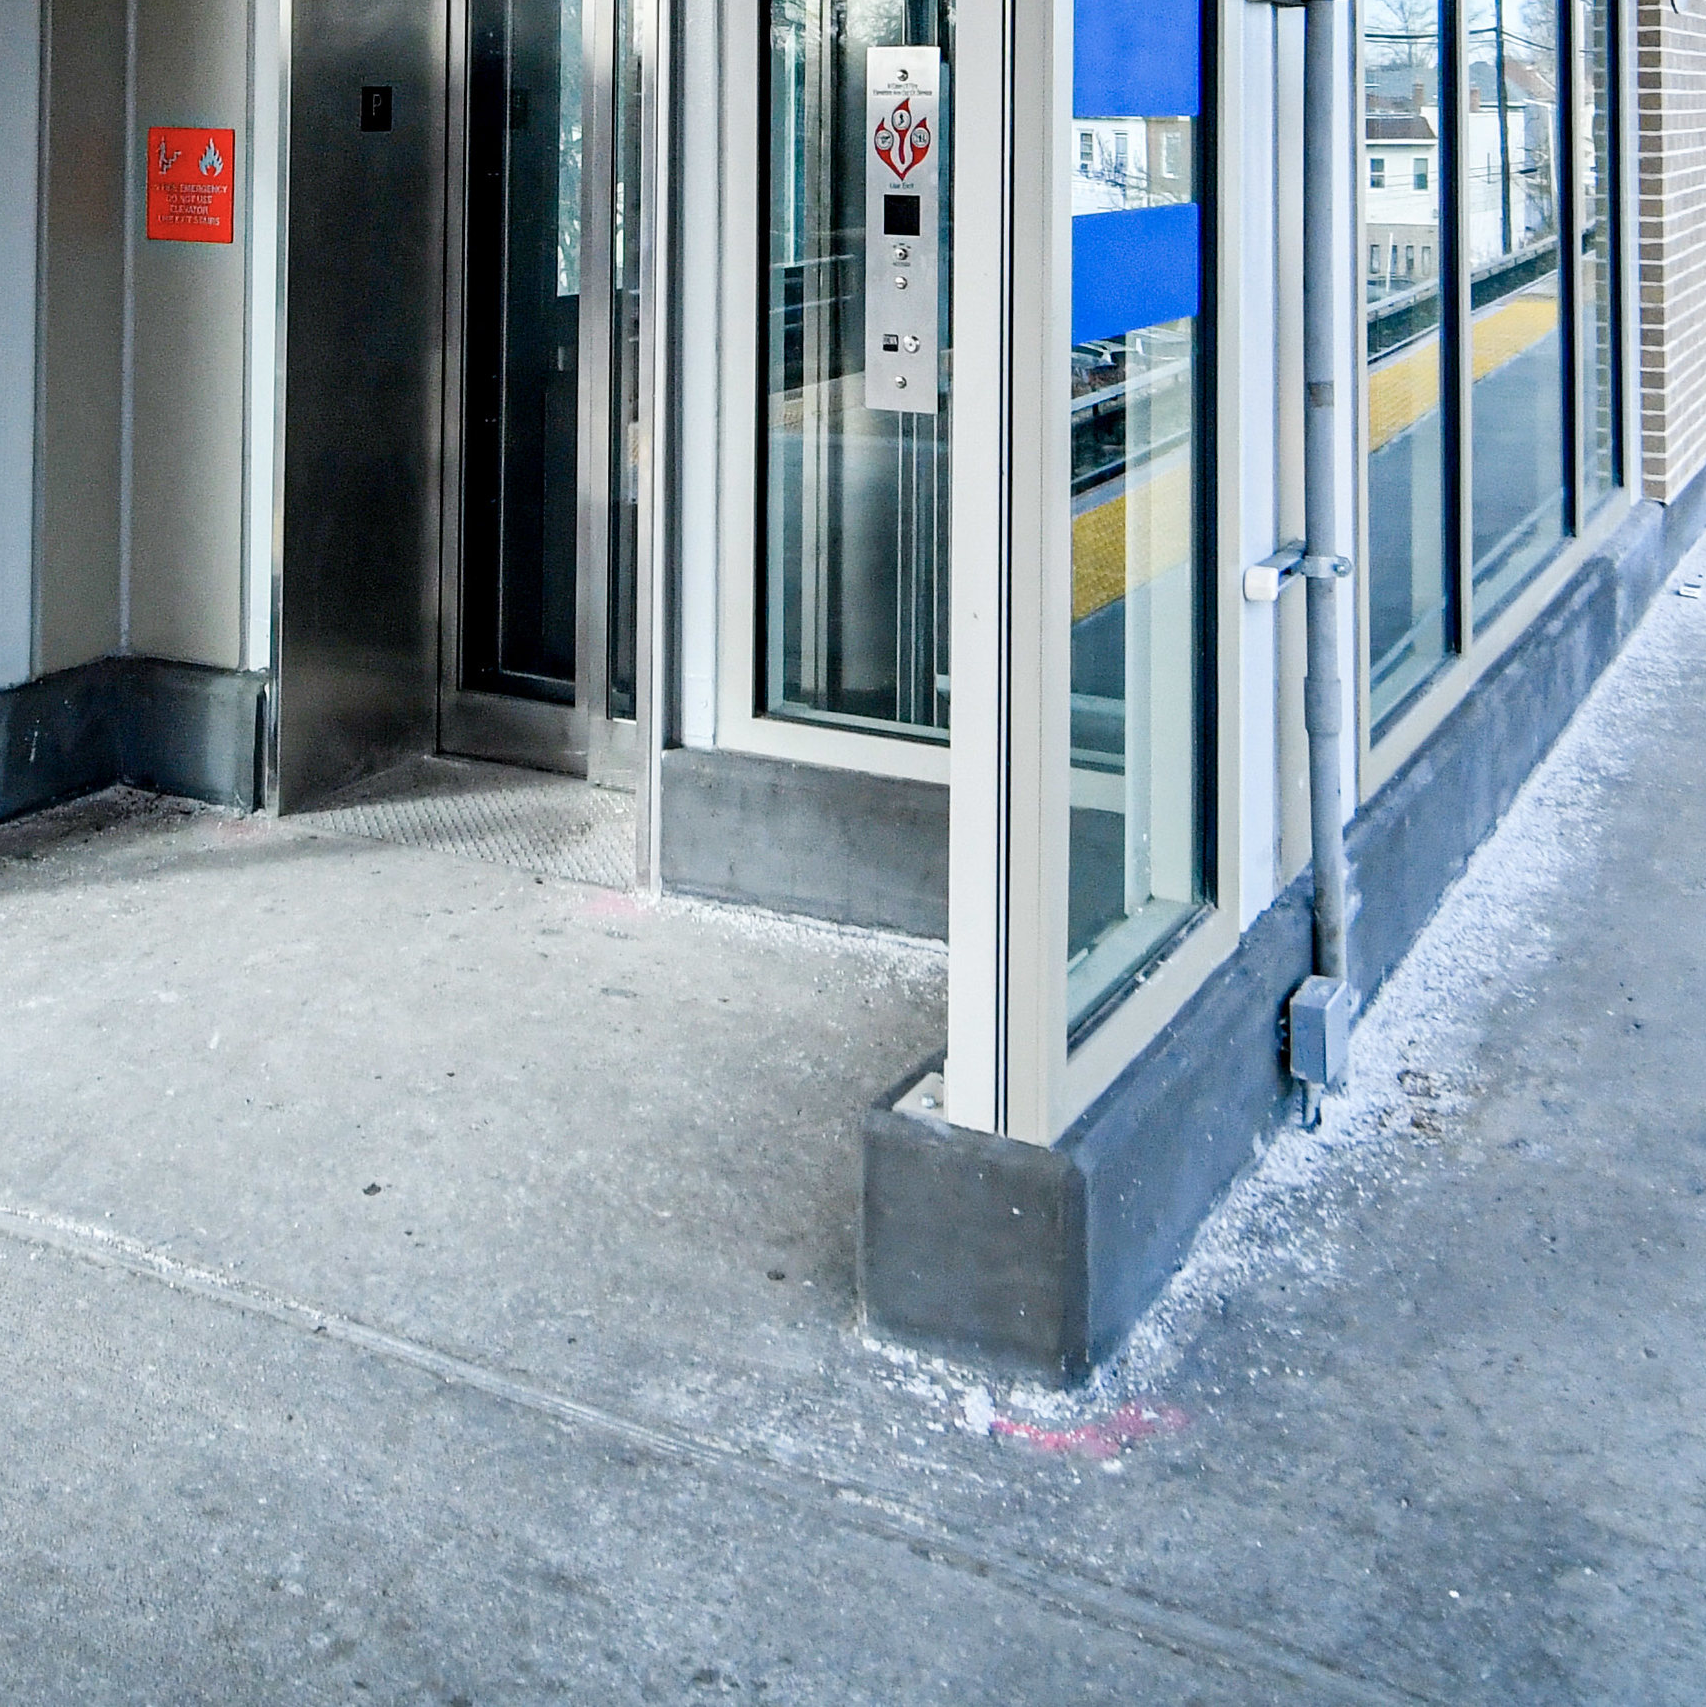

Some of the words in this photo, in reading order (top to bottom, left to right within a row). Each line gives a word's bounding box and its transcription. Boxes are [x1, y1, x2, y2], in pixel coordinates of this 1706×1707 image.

[372, 93, 382, 117] P
[180, 184, 228, 193] EMERGENCY
[197, 195, 213, 204] USE
[170, 205, 209, 215] ELEVATOR
